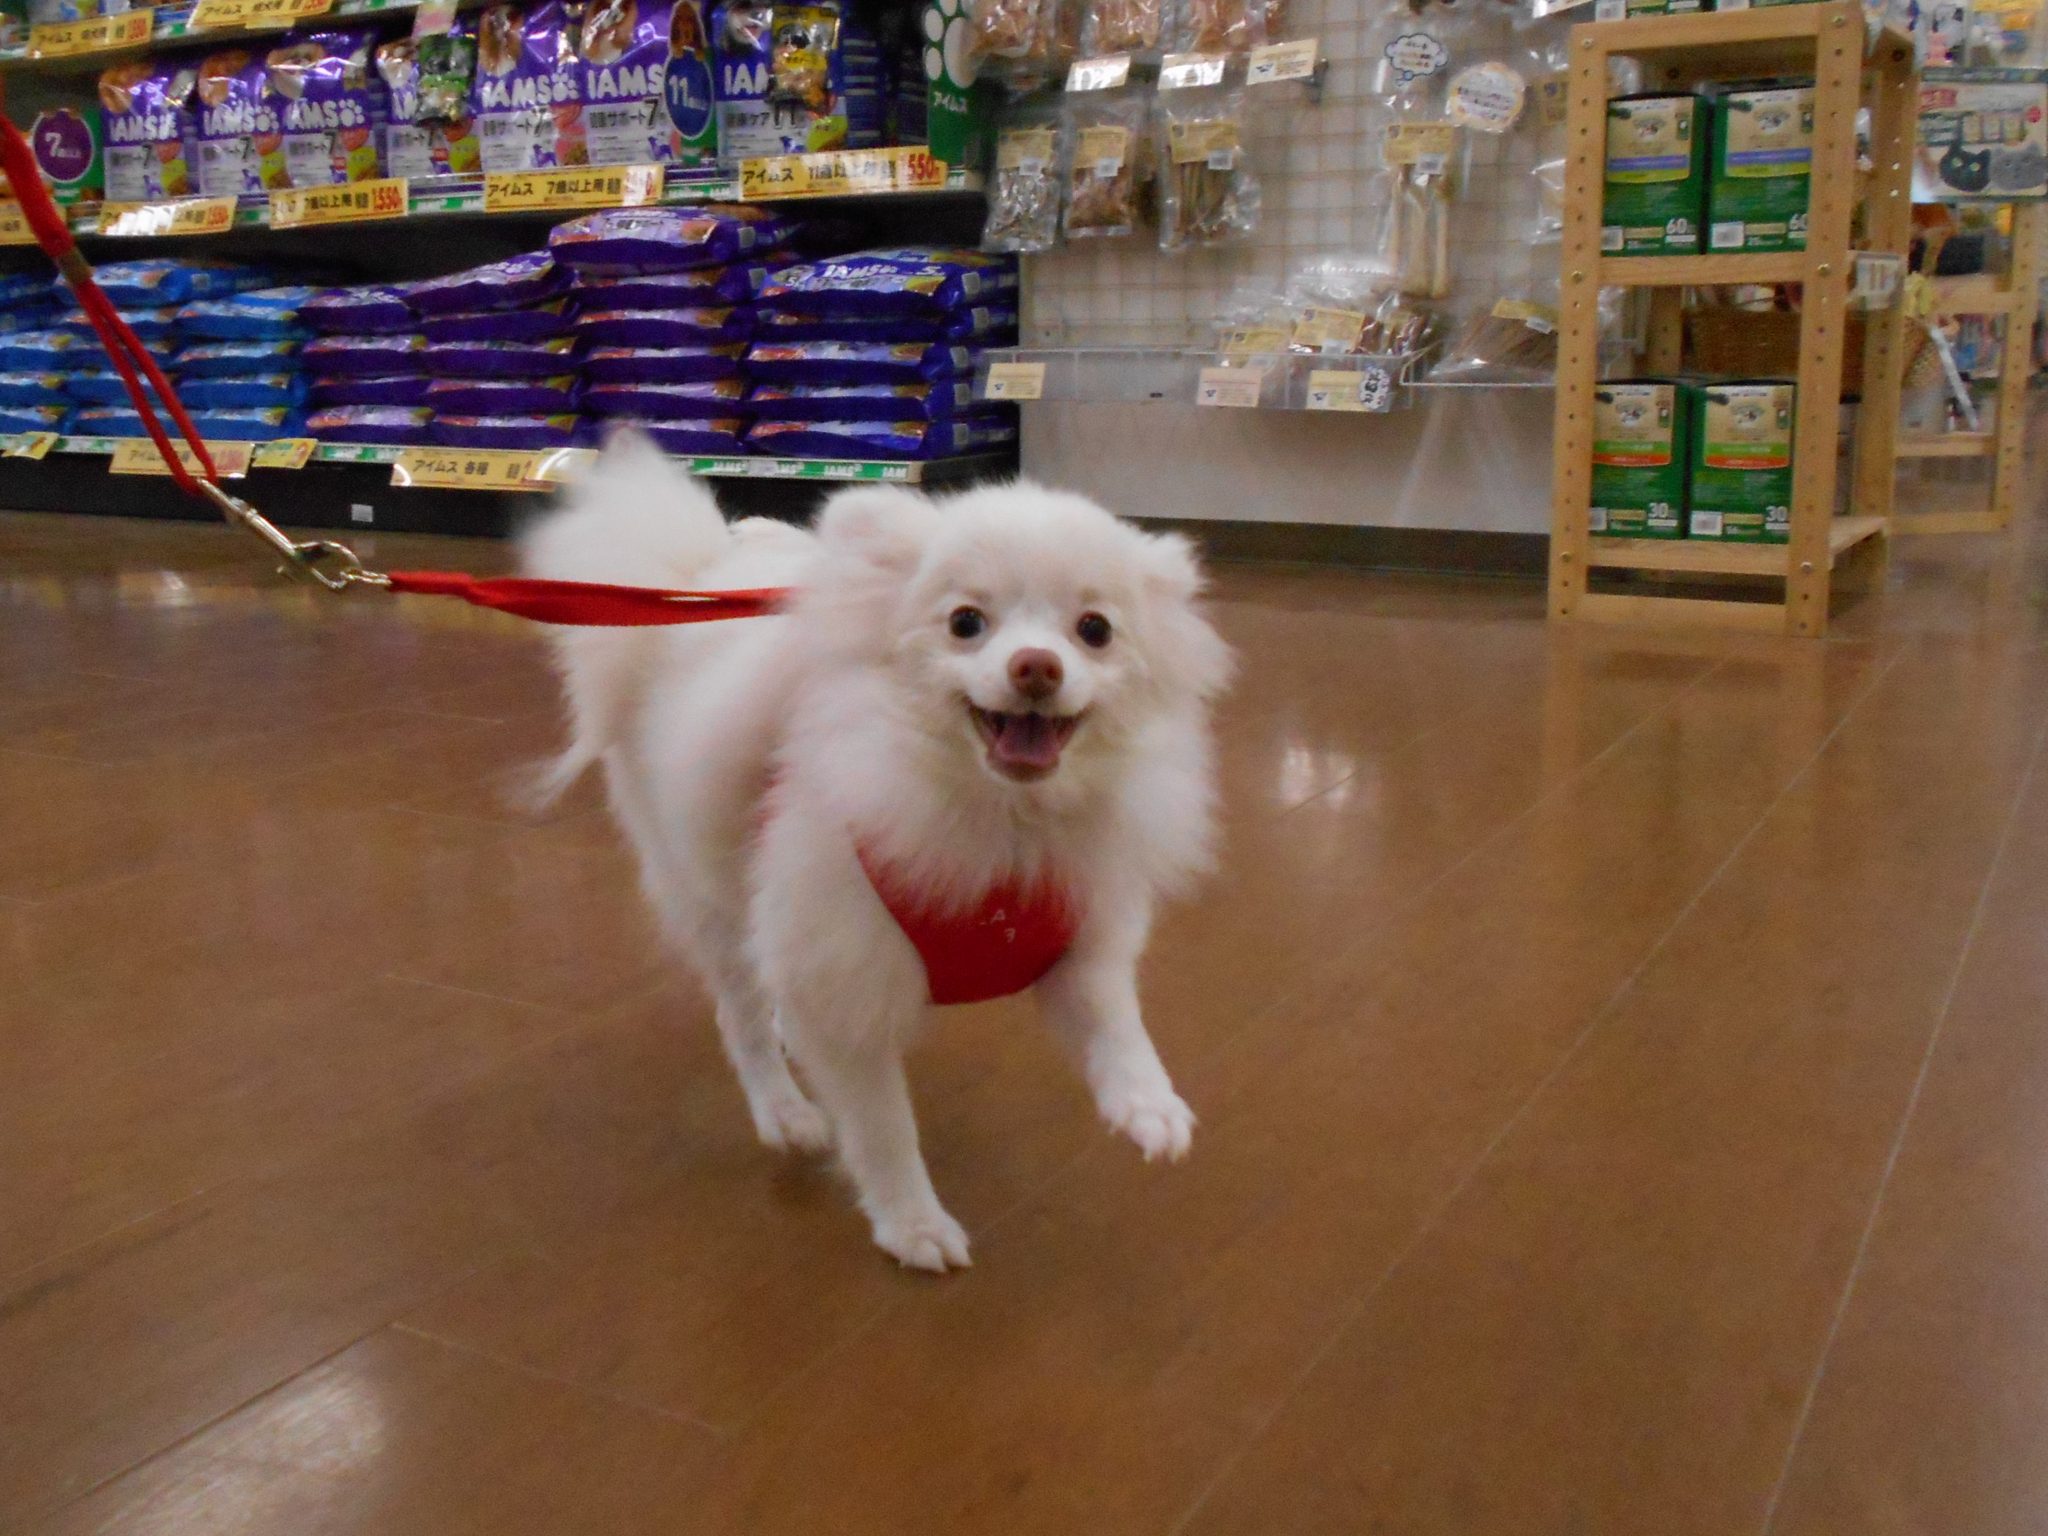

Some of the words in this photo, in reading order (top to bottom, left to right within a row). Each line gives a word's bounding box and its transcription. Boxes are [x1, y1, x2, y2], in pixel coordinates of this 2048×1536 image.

[588, 64, 664, 99] IAMS
[483, 75, 551, 107] IAMS
[488, 182, 534, 197] アイムス
[1666, 217, 1688, 235] 60
[412, 459, 457, 473] アイムス
[1649, 502, 1669, 518] 30
[1766, 505, 1788, 522] 30
